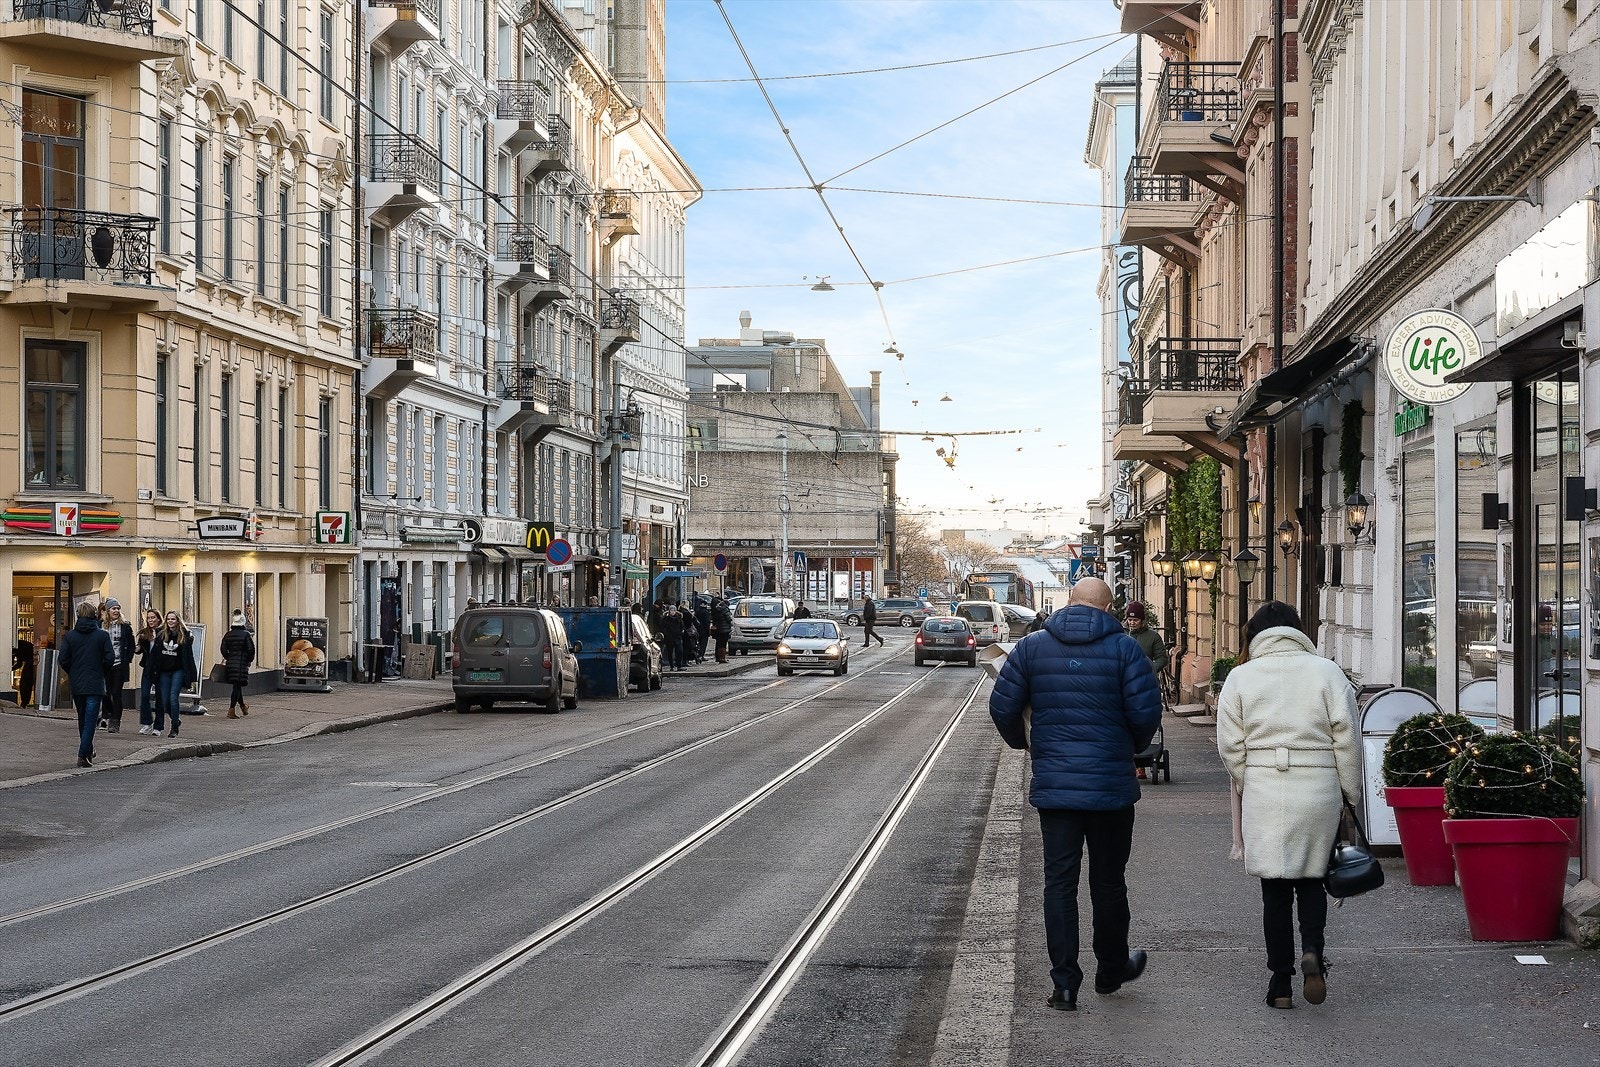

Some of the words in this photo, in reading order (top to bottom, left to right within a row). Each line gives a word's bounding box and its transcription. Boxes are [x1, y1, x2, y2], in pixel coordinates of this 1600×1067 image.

[1392, 320, 1418, 358] EXPERT
[1420, 315, 1459, 330] ADVICE
[1458, 328, 1478, 356] FROM
[1394, 368, 1426, 398] PEOPLE
[1430, 388, 1455, 400] WHO
[60, 506, 77, 535] 7
[207, 524, 238, 532] MINIBANK
[322, 516, 343, 544] 7
